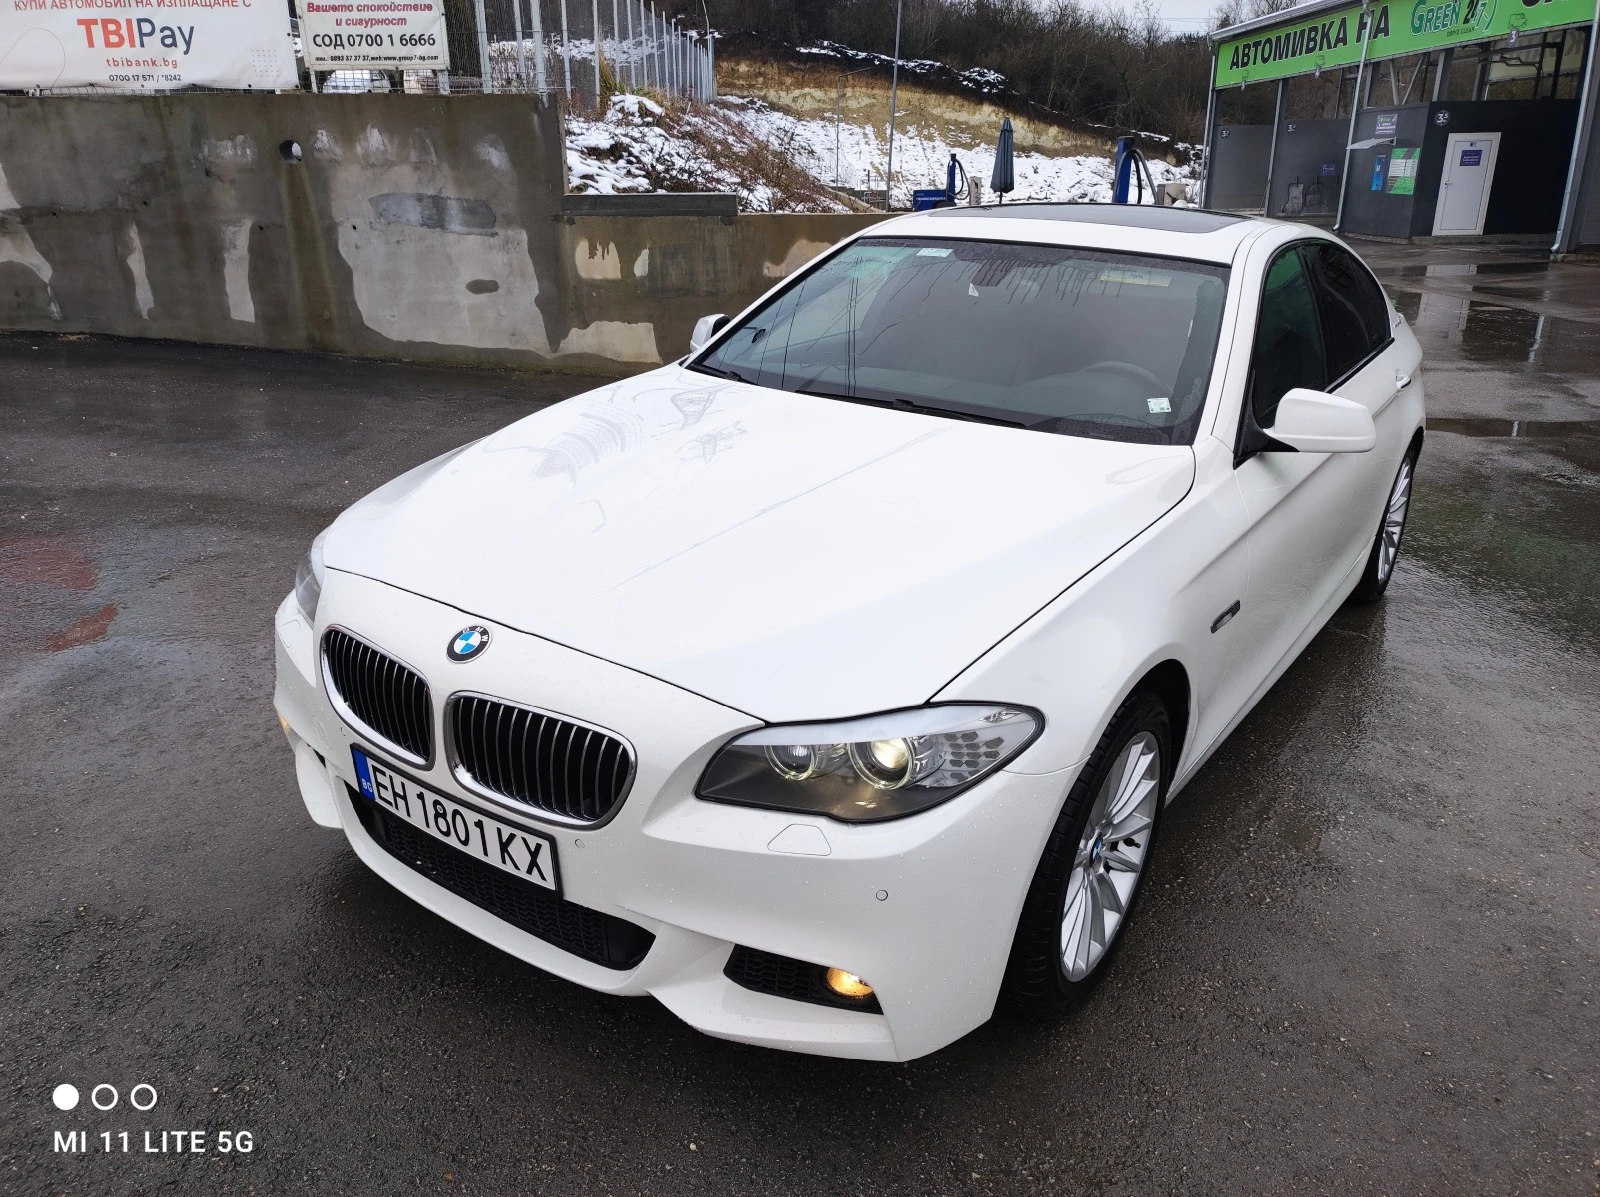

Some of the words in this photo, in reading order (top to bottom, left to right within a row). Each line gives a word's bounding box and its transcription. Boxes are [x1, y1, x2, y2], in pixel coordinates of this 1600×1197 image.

[14, 0, 49, 11] КУПИ
[50, 0, 131, 10] АВТОМОБИЛ
[135, 0, 154, 8] НА
[157, 0, 239, 9] ИЗПЛАЩАНЕ
[307, 2, 354, 13] Вашето
[356, 1, 433, 12] спокойствие
[335, 18, 343, 26] и
[345, 17, 407, 28] сигурност
[1411, 0, 1461, 36] GREEN
[312, 34, 345, 50] СОД
[347, 34, 383, 47] 0700
[387, 34, 395, 47] 1
[399, 33, 436, 47] 6666
[1229, 16, 1348, 71] АВТОМИВКА
[1355, 4, 1390, 44] НА
[106, 57, 178, 69] tbibank.bg
[108, 74, 131, 82] 0700
[132, 74, 140, 82] 17
[142, 74, 155, 82] 571
[361, 778, 373, 793] BG
[371, 764, 412, 819] EH
[416, 790, 490, 858] 1801
[496, 826, 548, 882] KX
